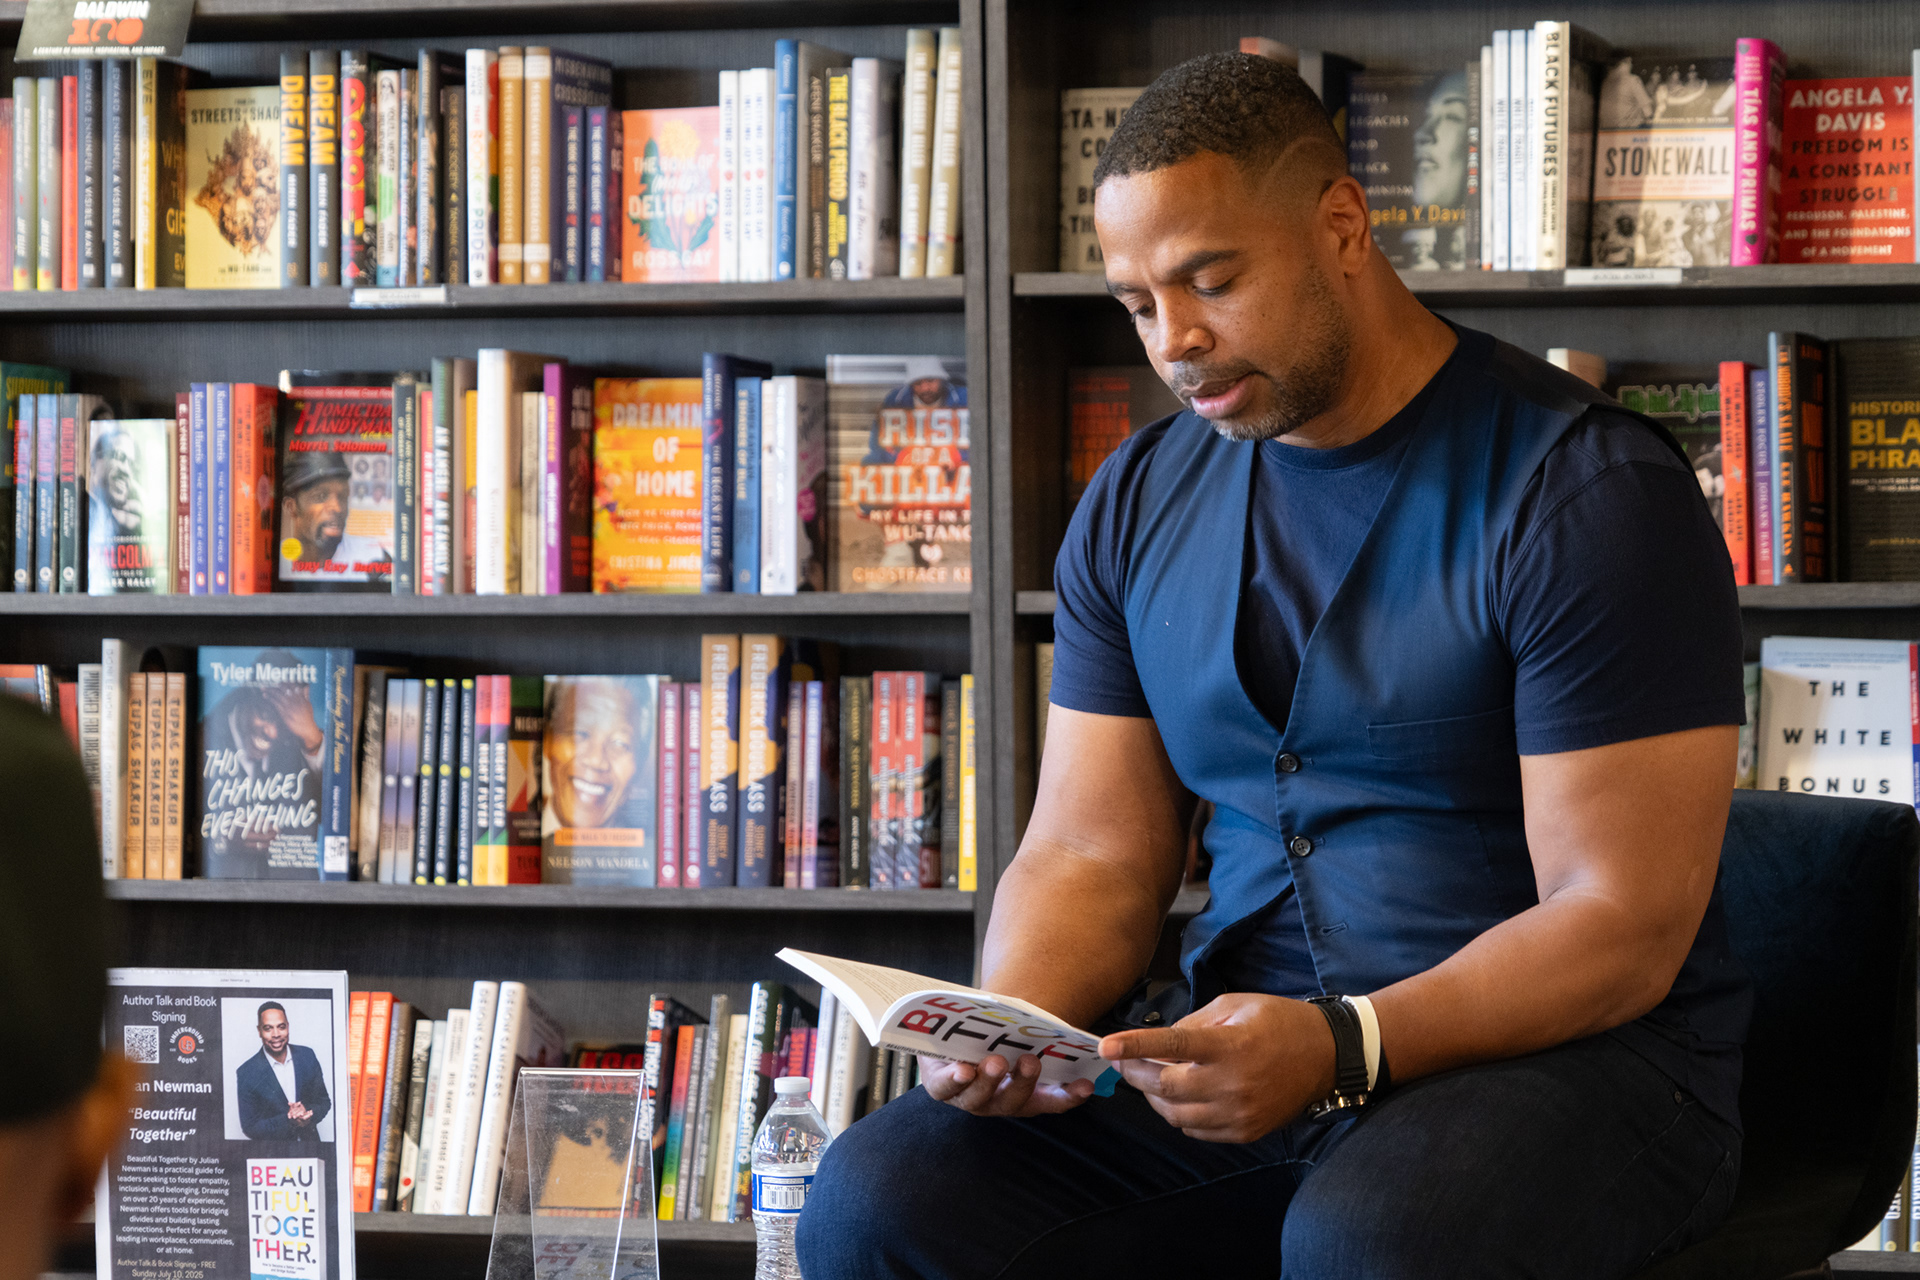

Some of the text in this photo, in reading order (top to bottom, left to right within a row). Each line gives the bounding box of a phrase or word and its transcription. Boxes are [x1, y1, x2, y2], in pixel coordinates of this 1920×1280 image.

[73, 1, 150, 18] BALDWIN
[141, 70, 152, 104] EVE
[829, 75, 848, 101] THE
[1790, 86, 1913, 108] ANGELA Y.
[191, 108, 241, 124] STREETS
[1543, 32, 1559, 177] BLACK FUTURES
[1743, 87, 1761, 126] TÍAS
[281, 75, 305, 165] DREAM
[310, 74, 336, 165] DREAM
[810, 76, 821, 164] AFENI SHAKUR
[829, 102, 848, 148] BLACK
[1815, 112, 1886, 133] DAVIS
[1742, 129, 1758, 164] AND
[1792, 137, 1909, 154] FREEDOM IS
[1605, 146, 1730, 177] STONEWALL
[1788, 162, 1912, 179] A CONSTANT
[829, 149, 848, 200] PERIOD
[629, 192, 719, 218] DELIGHTS
[1740, 168, 1757, 231] PRIMAS
[1801, 187, 1898, 203] STRUGGLE
[1786, 208, 1910, 222] FERGUSON, PALESTINE,
[1785, 226, 1911, 239] AND THE FOUNDATIONS
[632, 249, 713, 269] ROSS GAY
[1802, 245, 1893, 257] OF A MOVEMENT
[195, 391, 204, 464] Kamala Harris
[613, 403, 702, 429] DREAMIN
[1756, 380, 1770, 466] STOLEN FOCUS
[1851, 418, 1920, 445] BLA
[288, 439, 387, 452] Morris Solomon
[653, 436, 680, 463] OF
[911, 448, 951, 462] OF A
[636, 471, 695, 497] HOME
[711, 466, 722, 522] URGENT
[850, 465, 971, 504] KILLA
[870, 509, 957, 523] MY LIFE IN
[1758, 482, 1771, 561] JOHANN HARI
[711, 526, 722, 558] LIFE
[210, 662, 317, 686] Tyler Merritt
[1809, 681, 1870, 697] THE
[709, 644, 729, 812] FREDERICK DOUGLASS
[747, 644, 768, 812] FREDERICK DOUGLASS
[905, 706, 915, 740] NEWTON
[1783, 728, 1892, 746] WHITE
[151, 698, 162, 825] TUPAC SHAKUR
[169, 698, 180, 825] TUPAC SHAKUR
[204, 748, 244, 778] THIS
[208, 768, 309, 810] CHANGES
[494, 742, 506, 827] NIGHT FLYER
[1779, 777, 1890, 794] BONUS
[202, 799, 317, 840] EVERYTHING
[707, 819, 718, 866] MORRISON
[718, 825, 728, 858] SIDNEY
[744, 819, 755, 866] MORRISON
[755, 825, 766, 858] SIDNEY
[548, 857, 649, 869] NELSON MANDELA
[122, 994, 217, 1007] Author Talk and Book
[151, 1010, 187, 1025] Signing
[169, 1026, 204, 1044] UNDERGROUND
[465, 988, 489, 1098] DEION SANDERS
[492, 988, 516, 1098] DEION SANDERS
[177, 1055, 198, 1064] BOOKS
[886, 1043, 946, 1060] BEAUTIFUL TOGETHER
[153, 1080, 212, 1093] Newman
[360, 1076, 379, 1153] KENDRICK PERKINS
[129, 1127, 197, 1144] Together”
[122, 1165, 151, 1173] Newman
[164, 1166, 194, 1174] practical
[194, 1166, 214, 1175] guide
[126, 1155, 157, 1163] Beautiful
[158, 1155, 188, 1165] Together
[189, 1157, 198, 1165] by
[117, 1175, 142, 1183] leaders
[143, 1176, 168, 1185] seeking
[177, 1176, 198, 1184] foster
[199, 1178, 230, 1186] empathy,
[251, 1165, 313, 1187] BEAU
[118, 1185, 151, 1193] inclusion,
[152, 1185, 165, 1193] and
[201, 1187, 229, 1196] Drawing
[149, 1195, 158, 1203] 20
[159, 1196, 178, 1205] years
[178, 1196, 186, 1204] of
[187, 1197, 226, 1206] experience,
[251, 1190, 315, 1213] TIFUL
[120, 1205, 229, 1216] Newman offers tools for bridging
[129, 1215, 220, 1226] divides and building lasting
[122, 1225, 228, 1236] connections. Perfect for anyone
[251, 1214, 315, 1239] TOGE
[116, 1235, 235, 1246] leading in workplaces, communities,
[252, 1239, 317, 1264] THER.
[200, 1261, 217, 1269] FREE
